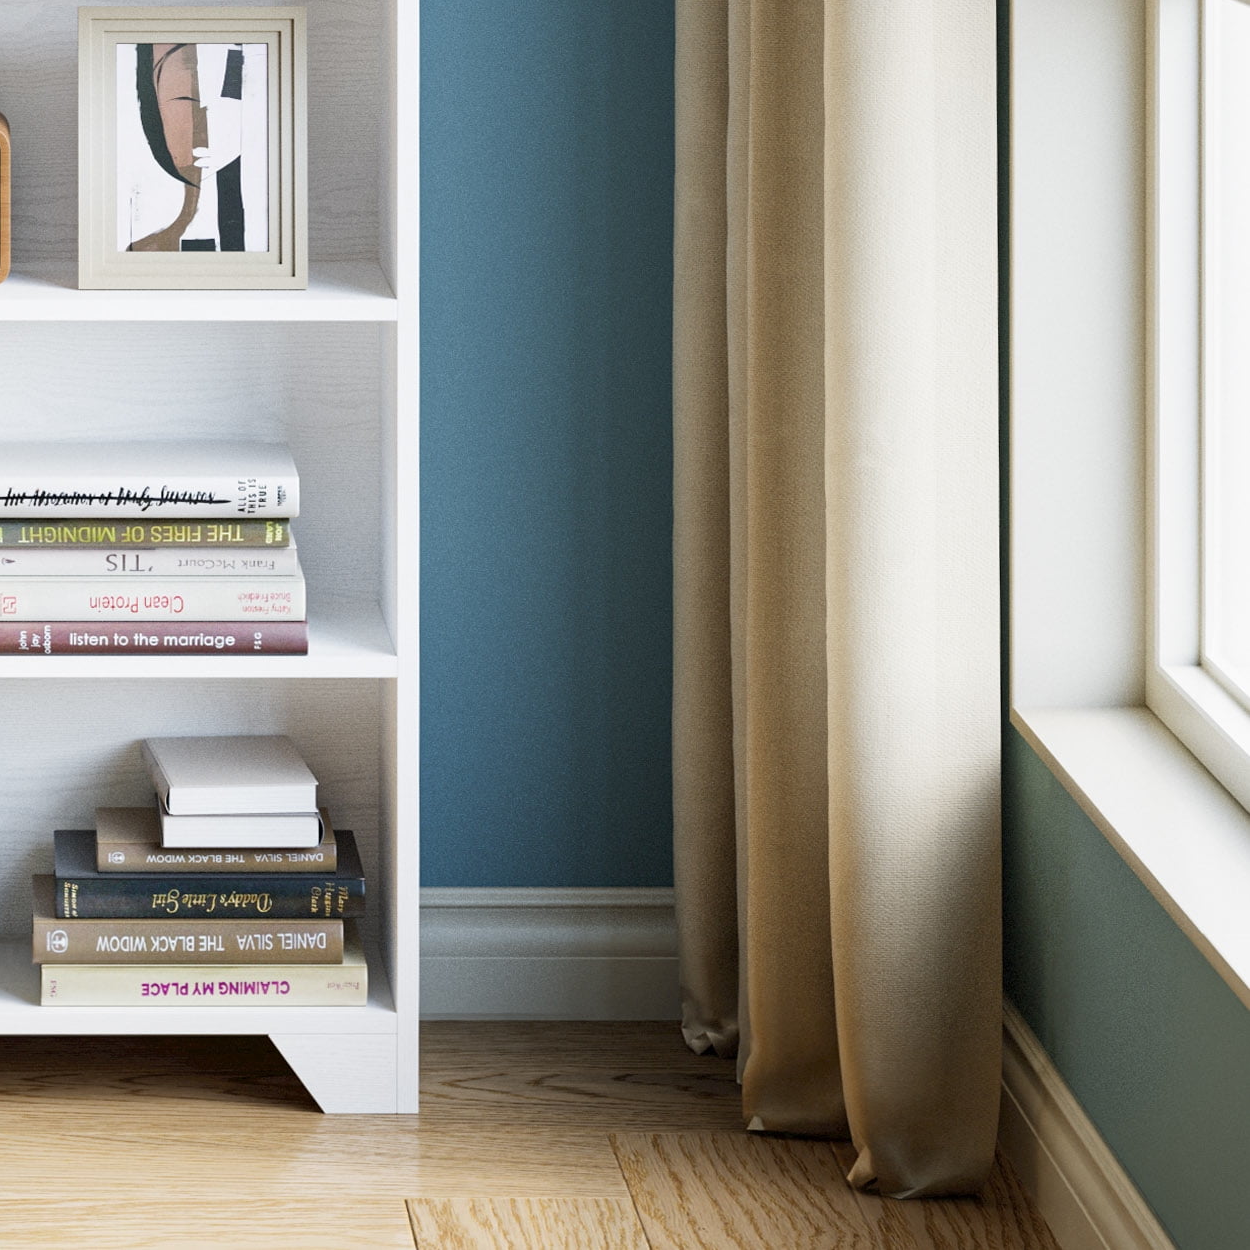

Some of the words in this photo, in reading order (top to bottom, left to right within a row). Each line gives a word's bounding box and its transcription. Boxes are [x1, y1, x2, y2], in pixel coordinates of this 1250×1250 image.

[247, 478, 257, 488] IS
[238, 494, 247, 513] ALL
[247, 492, 257, 514] THIS
[258, 485, 267, 508] TRUE
[18, 526, 116, 543] MIDNIGHT
[121, 525, 144, 543] OF
[150, 525, 200, 543] FIRES
[207, 524, 245, 542] THE
[177, 557, 236, 568] McCourt
[241, 558, 275, 569] Frank
[89, 595, 139, 613] Protein
[144, 595, 184, 613] Clean
[18, 630, 27, 650] john
[31, 633, 39, 648] jay
[43, 625, 51, 654] osborn
[69, 633, 111, 646] listen
[113, 634, 129, 646] to
[133, 633, 159, 646] the
[163, 633, 236, 650] marriage
[254, 632, 262, 649] FSG
[146, 854, 186, 863] WIDOW
[188, 854, 223, 863] BLACK
[225, 854, 245, 862] THE
[255, 853, 282, 862] SILVA
[285, 852, 324, 861] DANIEL
[152, 889, 180, 914] Girl
[182, 893, 218, 912] Little
[219, 893, 273, 913] Daddy's
[96, 936, 147, 952] WIDOW
[151, 936, 194, 951] BLACK
[199, 935, 224, 950] THE
[236, 934, 273, 949] SILVA
[277, 933, 326, 948] DANIEL
[141, 982, 189, 996] PLACE
[193, 981, 214, 996] MY
[219, 981, 290, 995] CLAIMING
